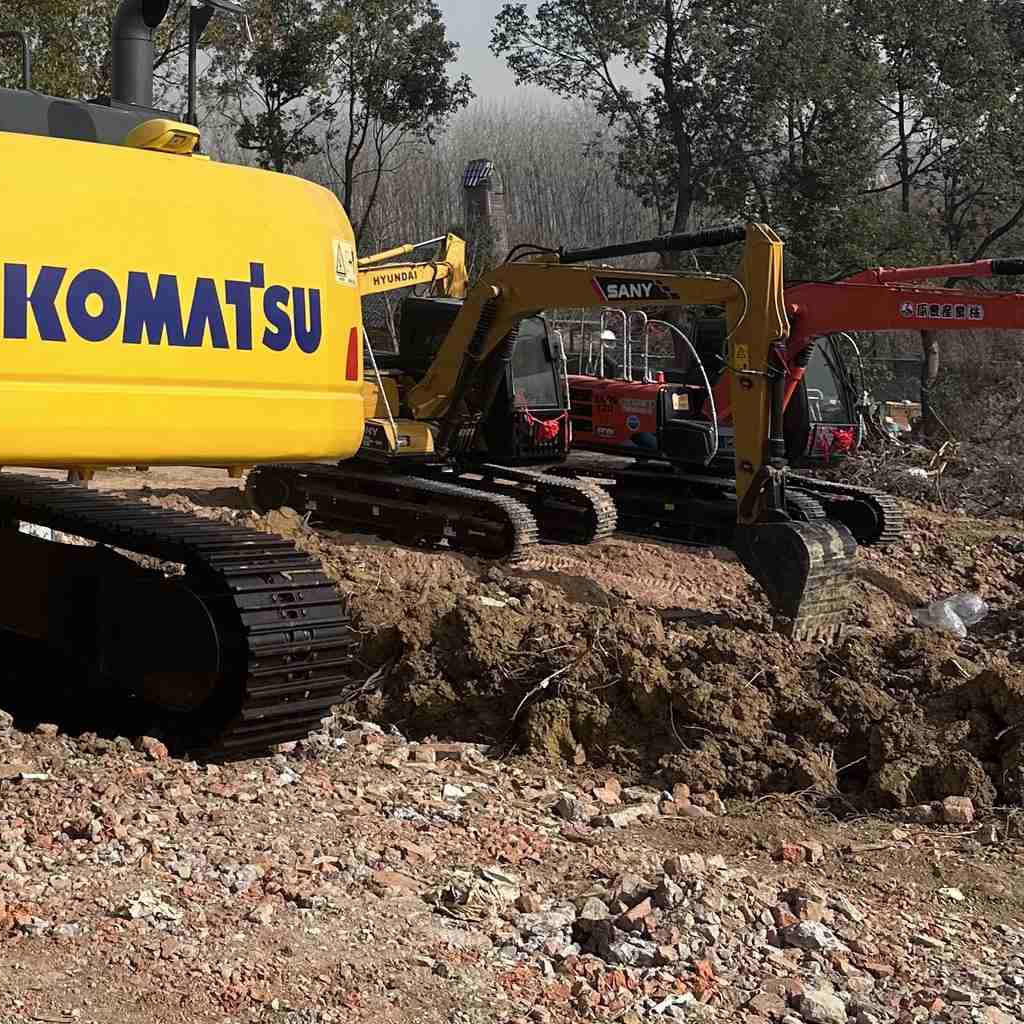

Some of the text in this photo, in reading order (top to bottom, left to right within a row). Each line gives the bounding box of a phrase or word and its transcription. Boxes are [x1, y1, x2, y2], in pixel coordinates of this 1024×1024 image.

[373, 270, 418, 285] HYUNDAI
[607, 282, 653, 298] SANY
[3, 262, 322, 354] KOMATSU
